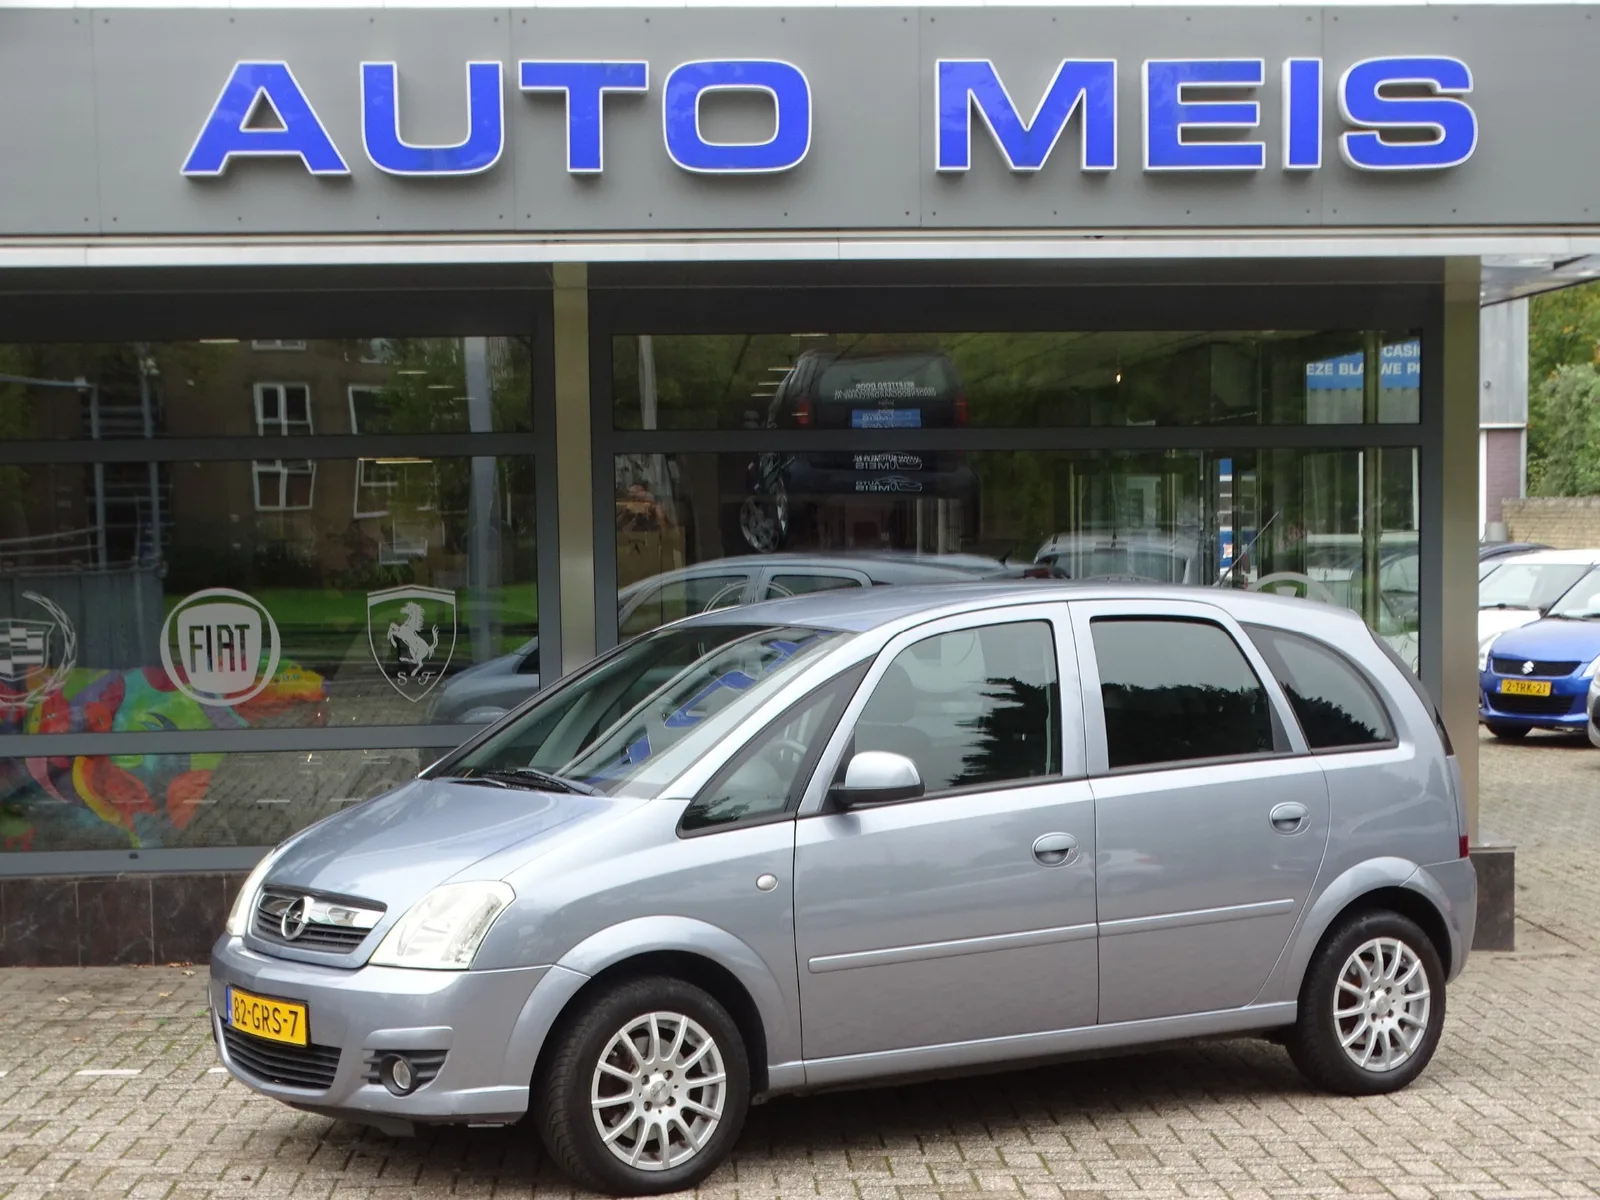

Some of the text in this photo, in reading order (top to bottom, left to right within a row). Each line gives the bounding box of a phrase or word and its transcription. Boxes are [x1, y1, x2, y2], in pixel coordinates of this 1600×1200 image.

[180, 55, 1479, 178] AUTO MEIS
[188, 624, 250, 673] FIAT
[1507, 682, 1546, 694] 2-TRK-21
[235, 997, 299, 1037] 82-GRS-7
